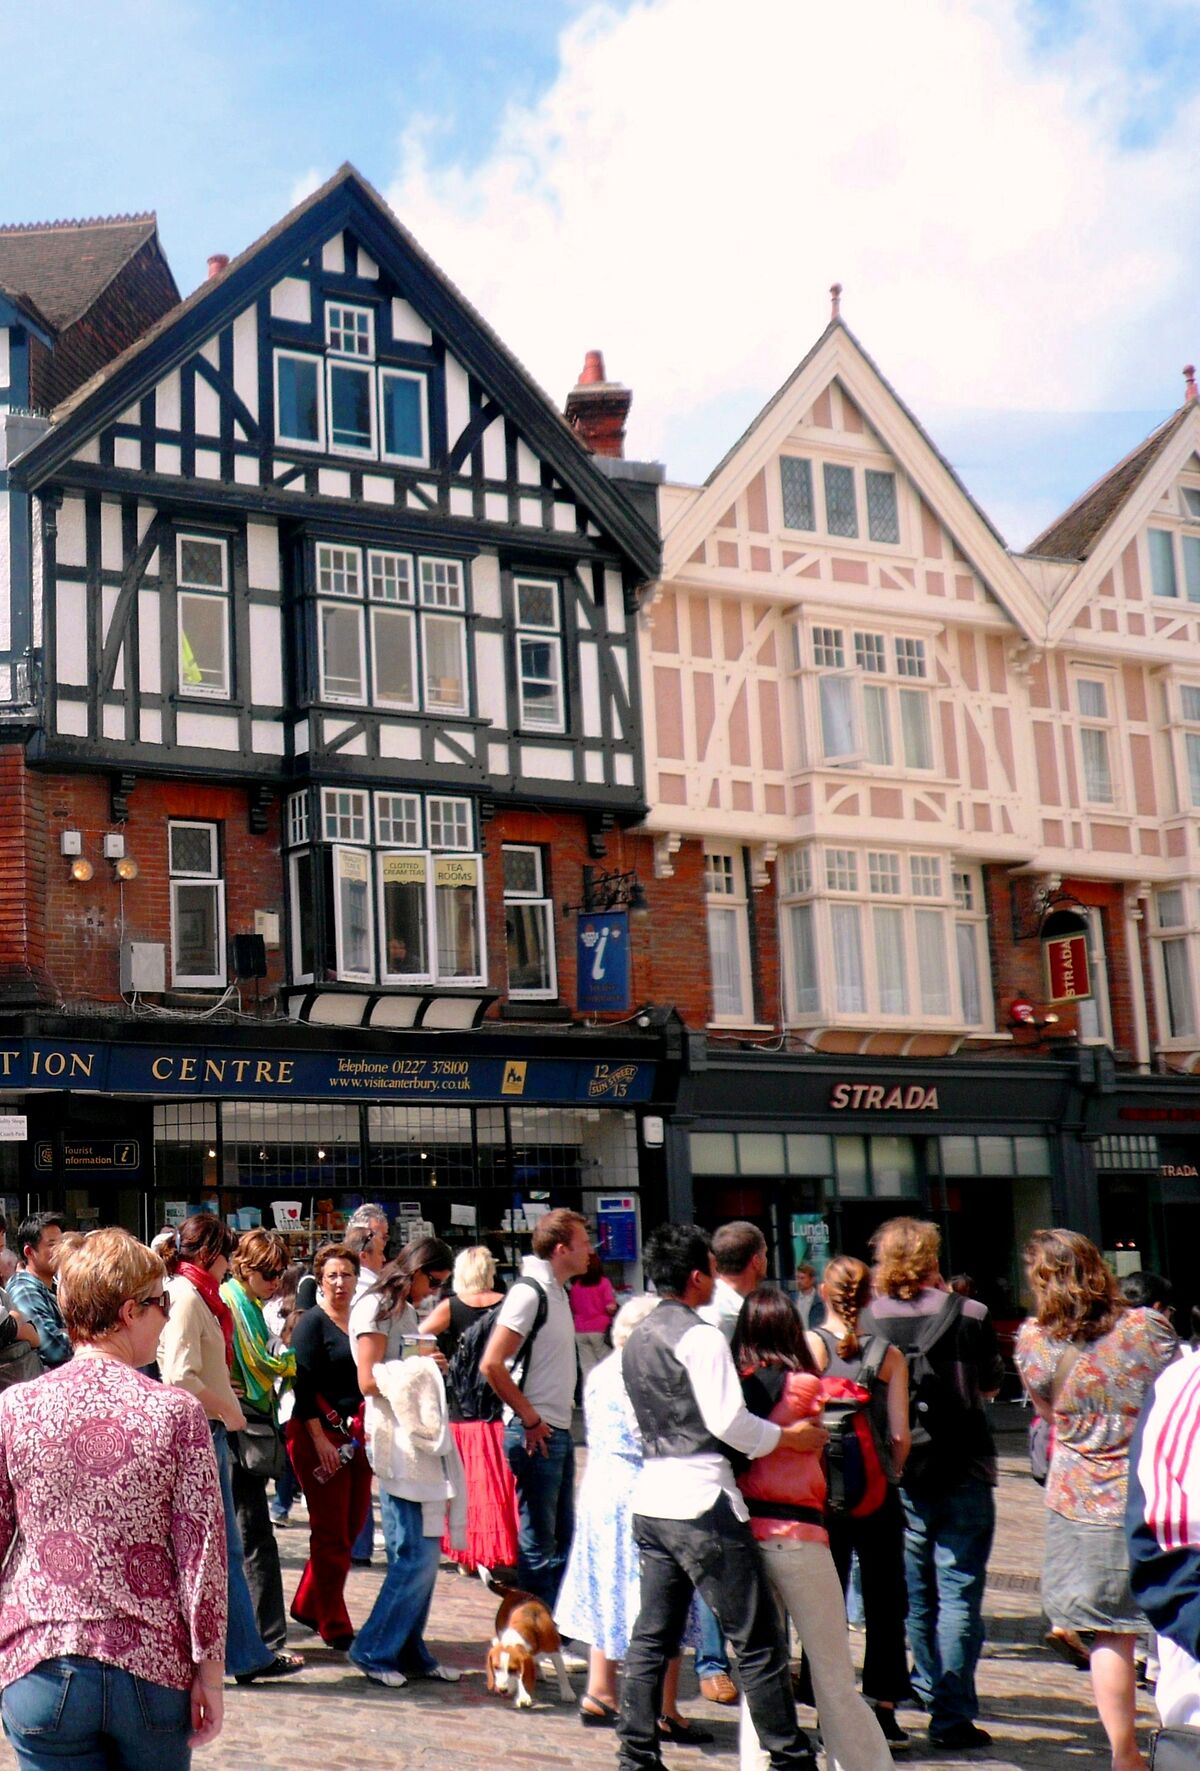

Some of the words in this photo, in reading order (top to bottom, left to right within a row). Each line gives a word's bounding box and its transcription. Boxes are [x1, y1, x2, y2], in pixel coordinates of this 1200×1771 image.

[446, 863, 463, 872] TEA
[437, 872, 472, 881] ROOMS
[1062, 939, 1076, 998] STRADA
[151, 1056, 295, 1083] CENTRE
[337, 1058, 388, 1075] Telephone
[392, 1060, 426, 1074] 01227
[431, 1060, 469, 1075] 378100
[595, 1064, 609, 1078] 12
[591, 1081, 609, 1094] SUN
[608, 1067, 636, 1086] STREET
[613, 1083, 628, 1097] 13
[830, 1083, 940, 1110] STRADA
[64, 1146, 93, 1155] Tourist
[65, 1155, 112, 1165] nformation
[1157, 1165, 1198, 1176] TRADA
[791, 1220, 830, 1237] Lunch
